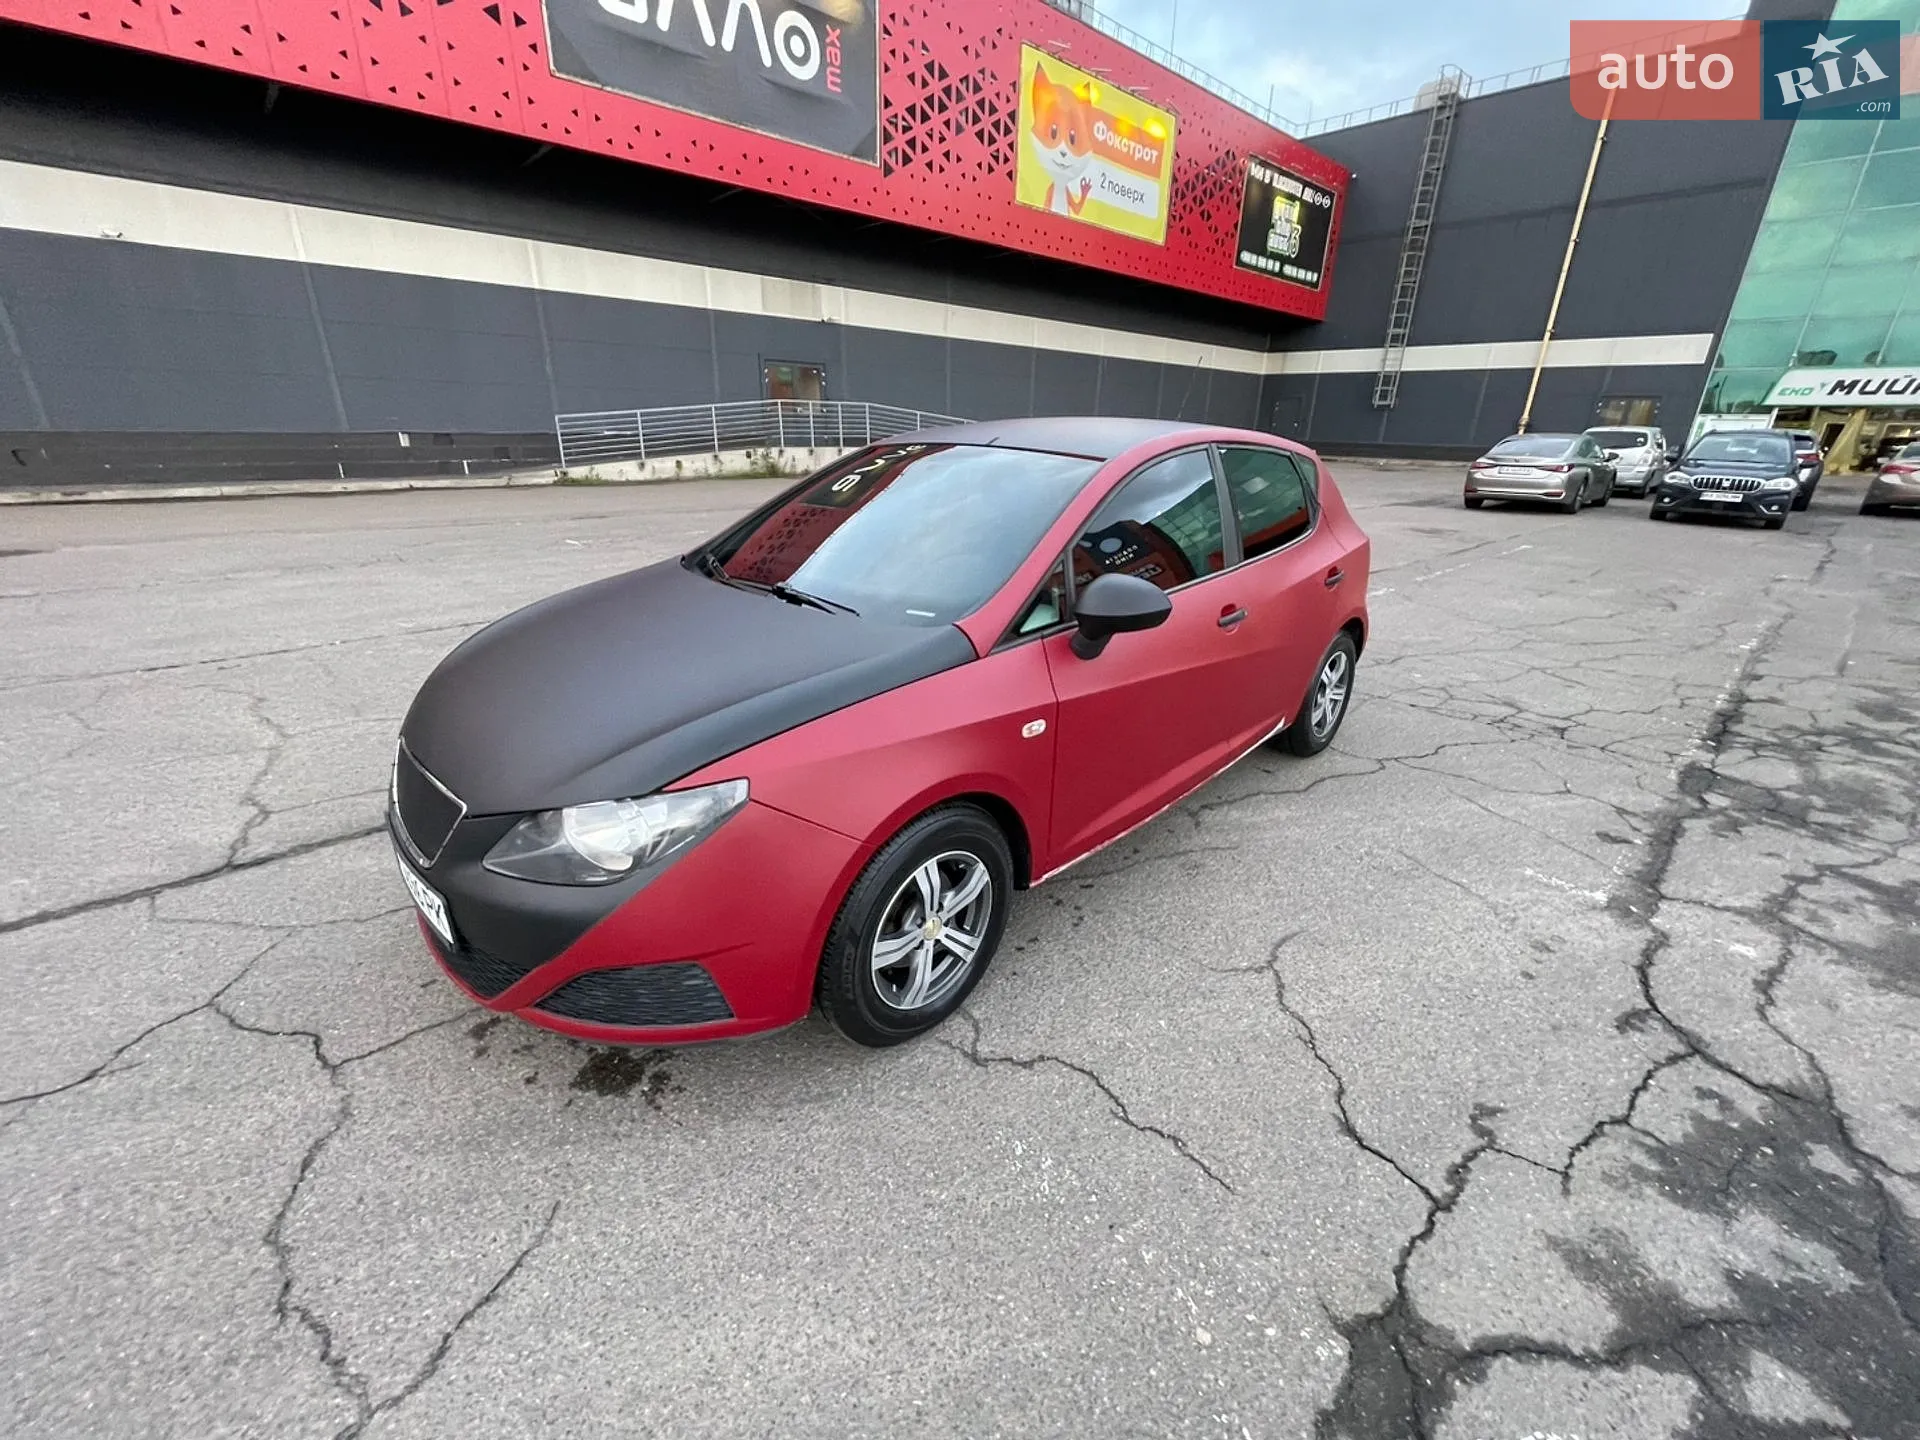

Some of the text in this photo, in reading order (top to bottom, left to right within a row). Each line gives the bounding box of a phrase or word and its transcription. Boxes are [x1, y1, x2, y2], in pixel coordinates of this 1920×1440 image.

[825, 24, 842, 94] max
[1093, 120, 1160, 165] Фокстрот
[1099, 172, 1146, 204] 2 поверх
